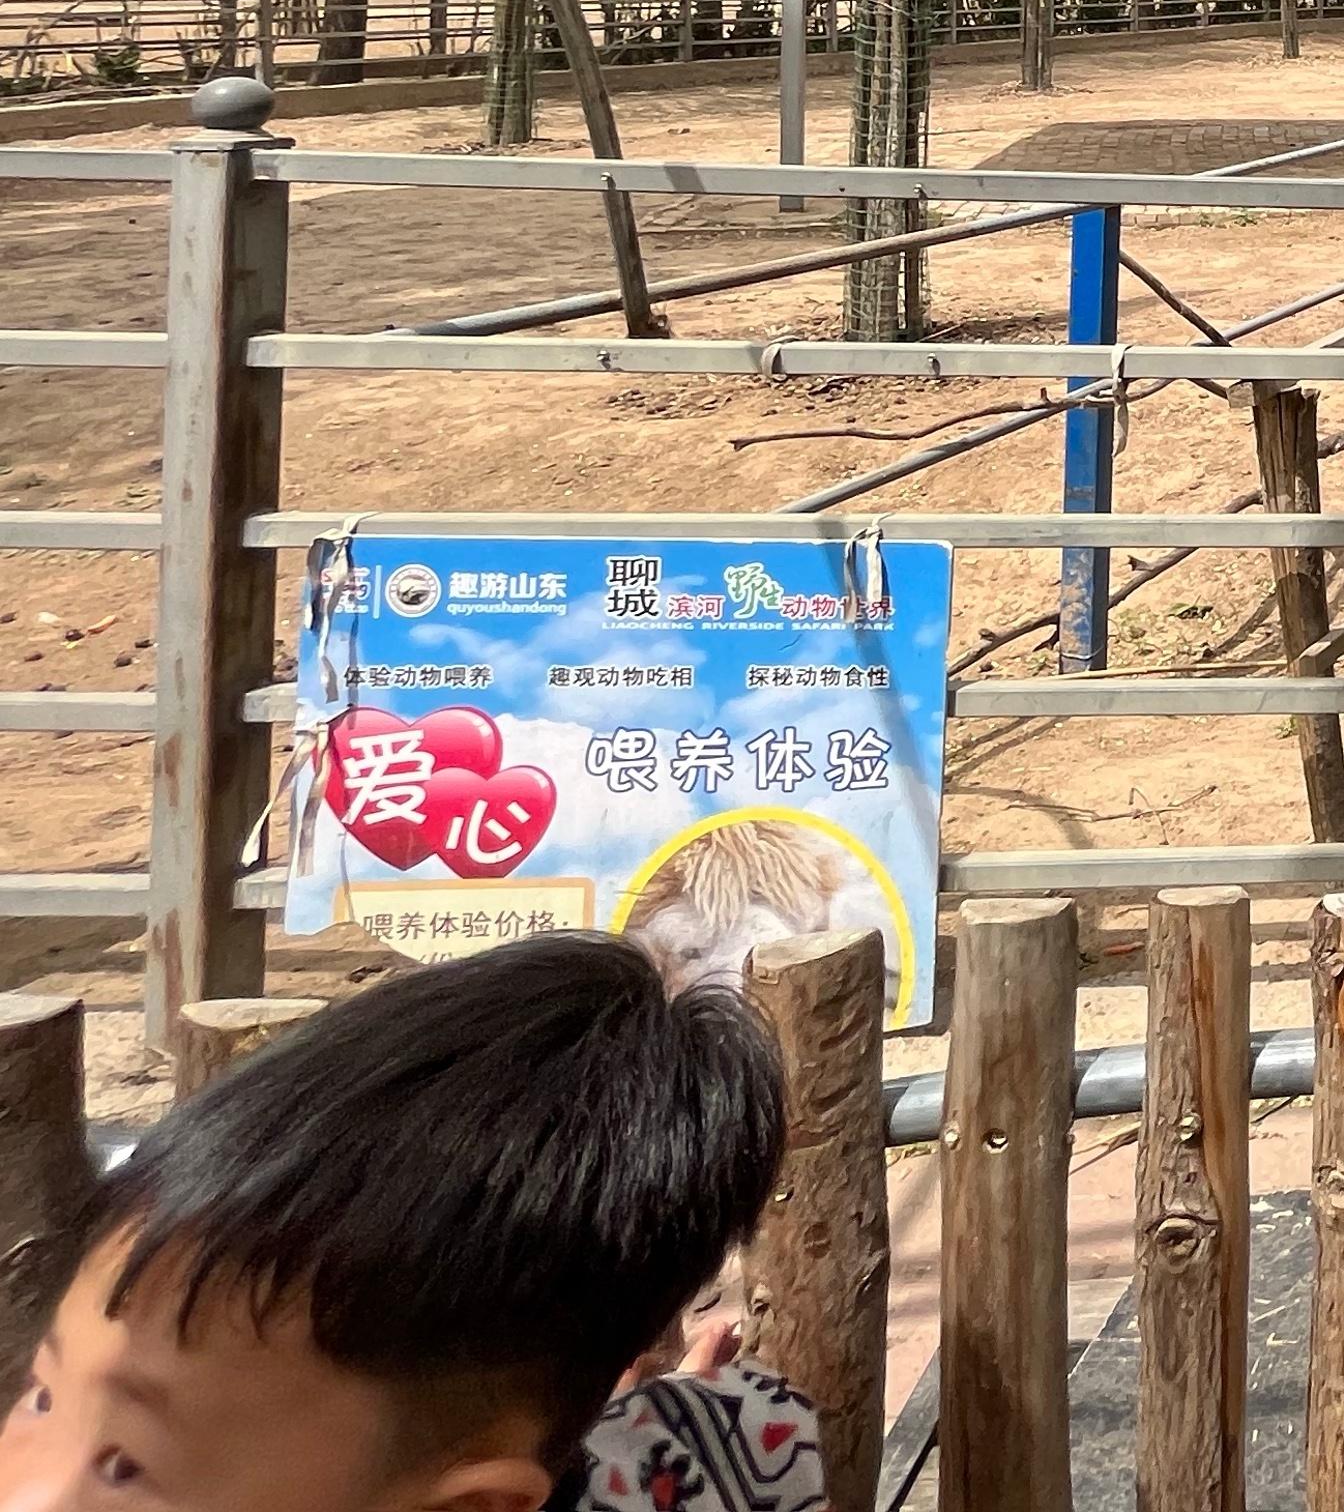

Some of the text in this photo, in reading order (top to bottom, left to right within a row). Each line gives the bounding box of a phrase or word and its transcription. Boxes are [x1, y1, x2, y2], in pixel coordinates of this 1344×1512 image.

[450, 572, 568, 599] 趣游山东
[606, 556, 661, 618] 聊城
[447, 602, 568, 616] quyoushandong
[602, 622, 695, 631] LIAOCHENG
[701, 622, 785, 631] RIVERSIDE
[791, 622, 847, 631] SAFARI
[344, 666, 492, 688] 体验动物喂养
[548, 666, 694, 688] 趣观动物吃相
[747, 665, 891, 688] 探秘动物食性
[586, 726, 893, 793] 喂养体验
